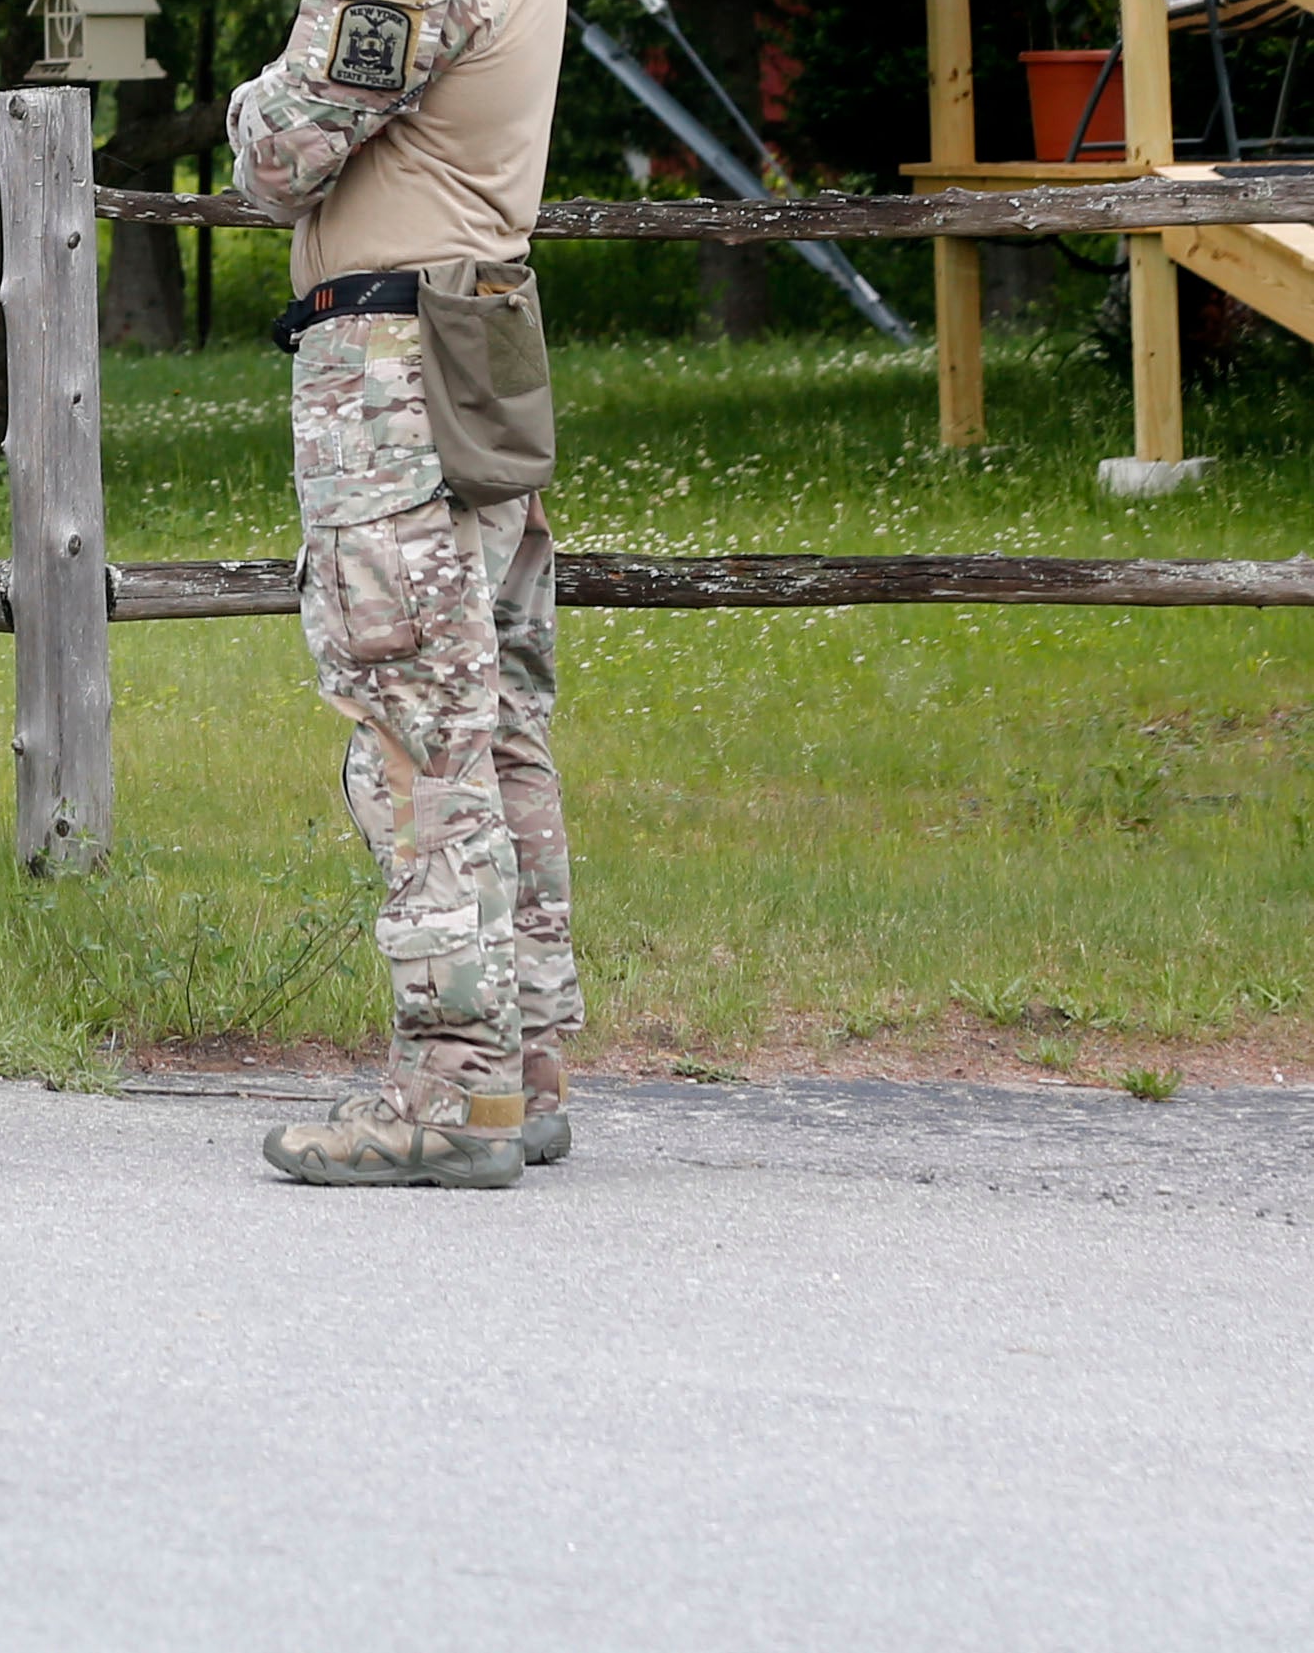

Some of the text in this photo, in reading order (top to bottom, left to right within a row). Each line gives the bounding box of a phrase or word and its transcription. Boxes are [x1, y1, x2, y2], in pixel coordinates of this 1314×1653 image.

[350, 7, 404, 26] NEW YORK
[336, 69, 397, 87] STATE POLICE
